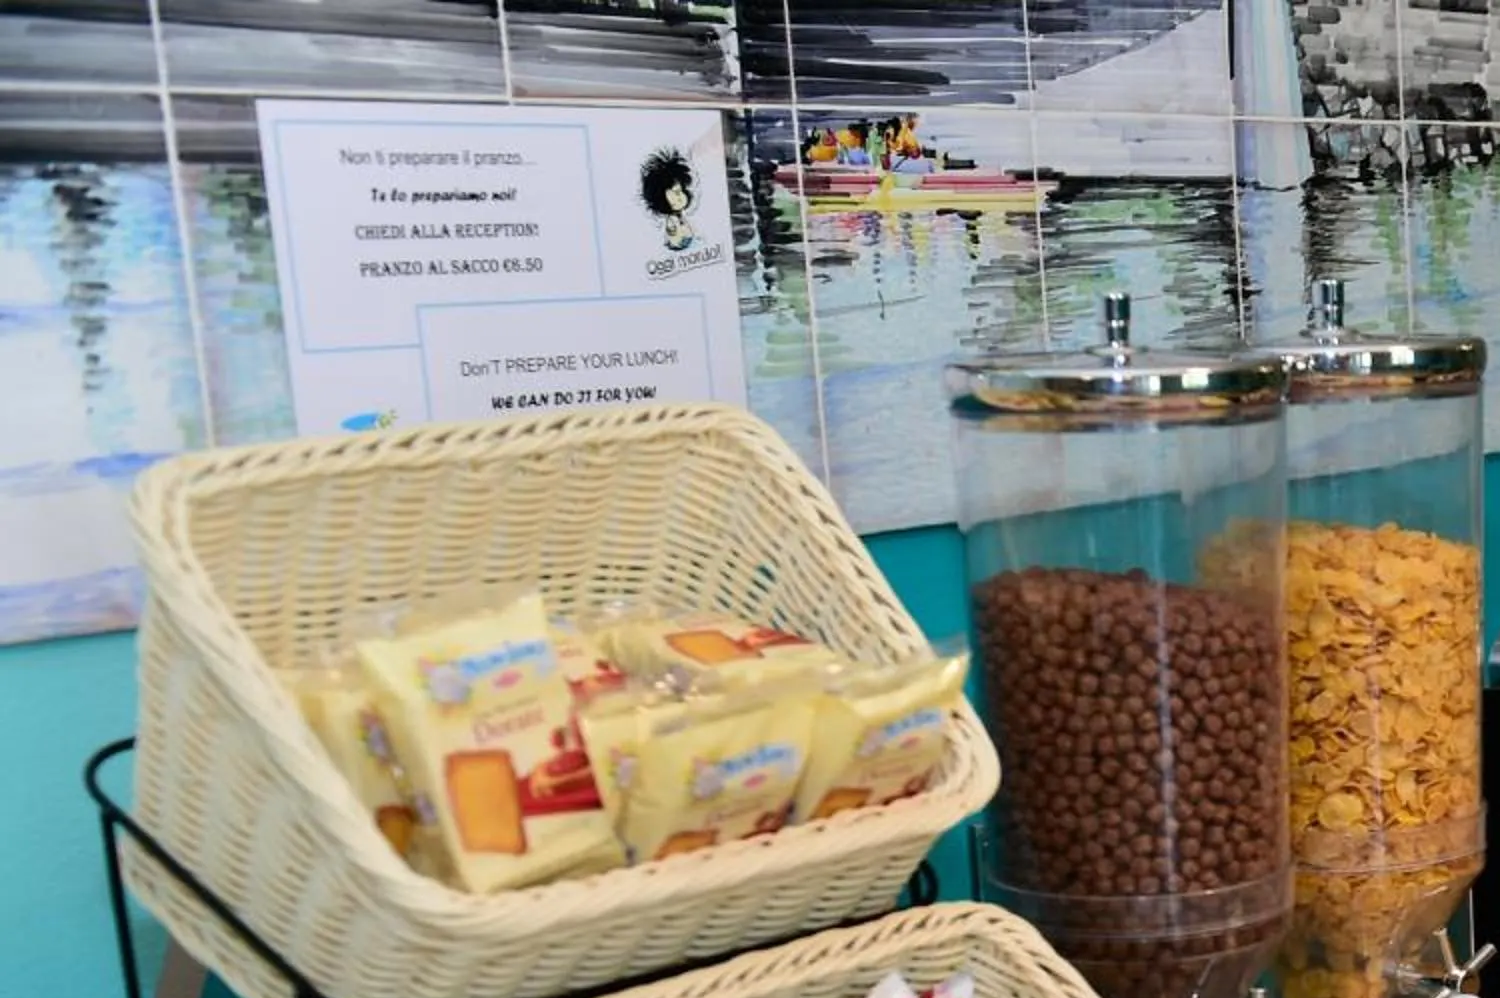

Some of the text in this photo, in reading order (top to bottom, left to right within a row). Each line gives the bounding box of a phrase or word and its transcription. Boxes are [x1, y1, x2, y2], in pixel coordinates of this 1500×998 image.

[340, 149, 371, 165] Non
[388, 152, 459, 168] preparare
[411, 189, 488, 205] prepariamo
[354, 224, 406, 240] CHIEDI
[410, 223, 451, 239] ALLA
[360, 261, 424, 277] PRANZO
[427, 260, 448, 275] AL
[451, 259, 500, 275] SACCO
[506, 355, 577, 374] PREPARE
[581, 352, 623, 370] YOUR
[626, 349, 678, 367] LUNCH!
[492, 396, 514, 410] WE
[518, 391, 549, 408] CAN
[554, 391, 574, 406] DO
[597, 387, 621, 402] FOR
